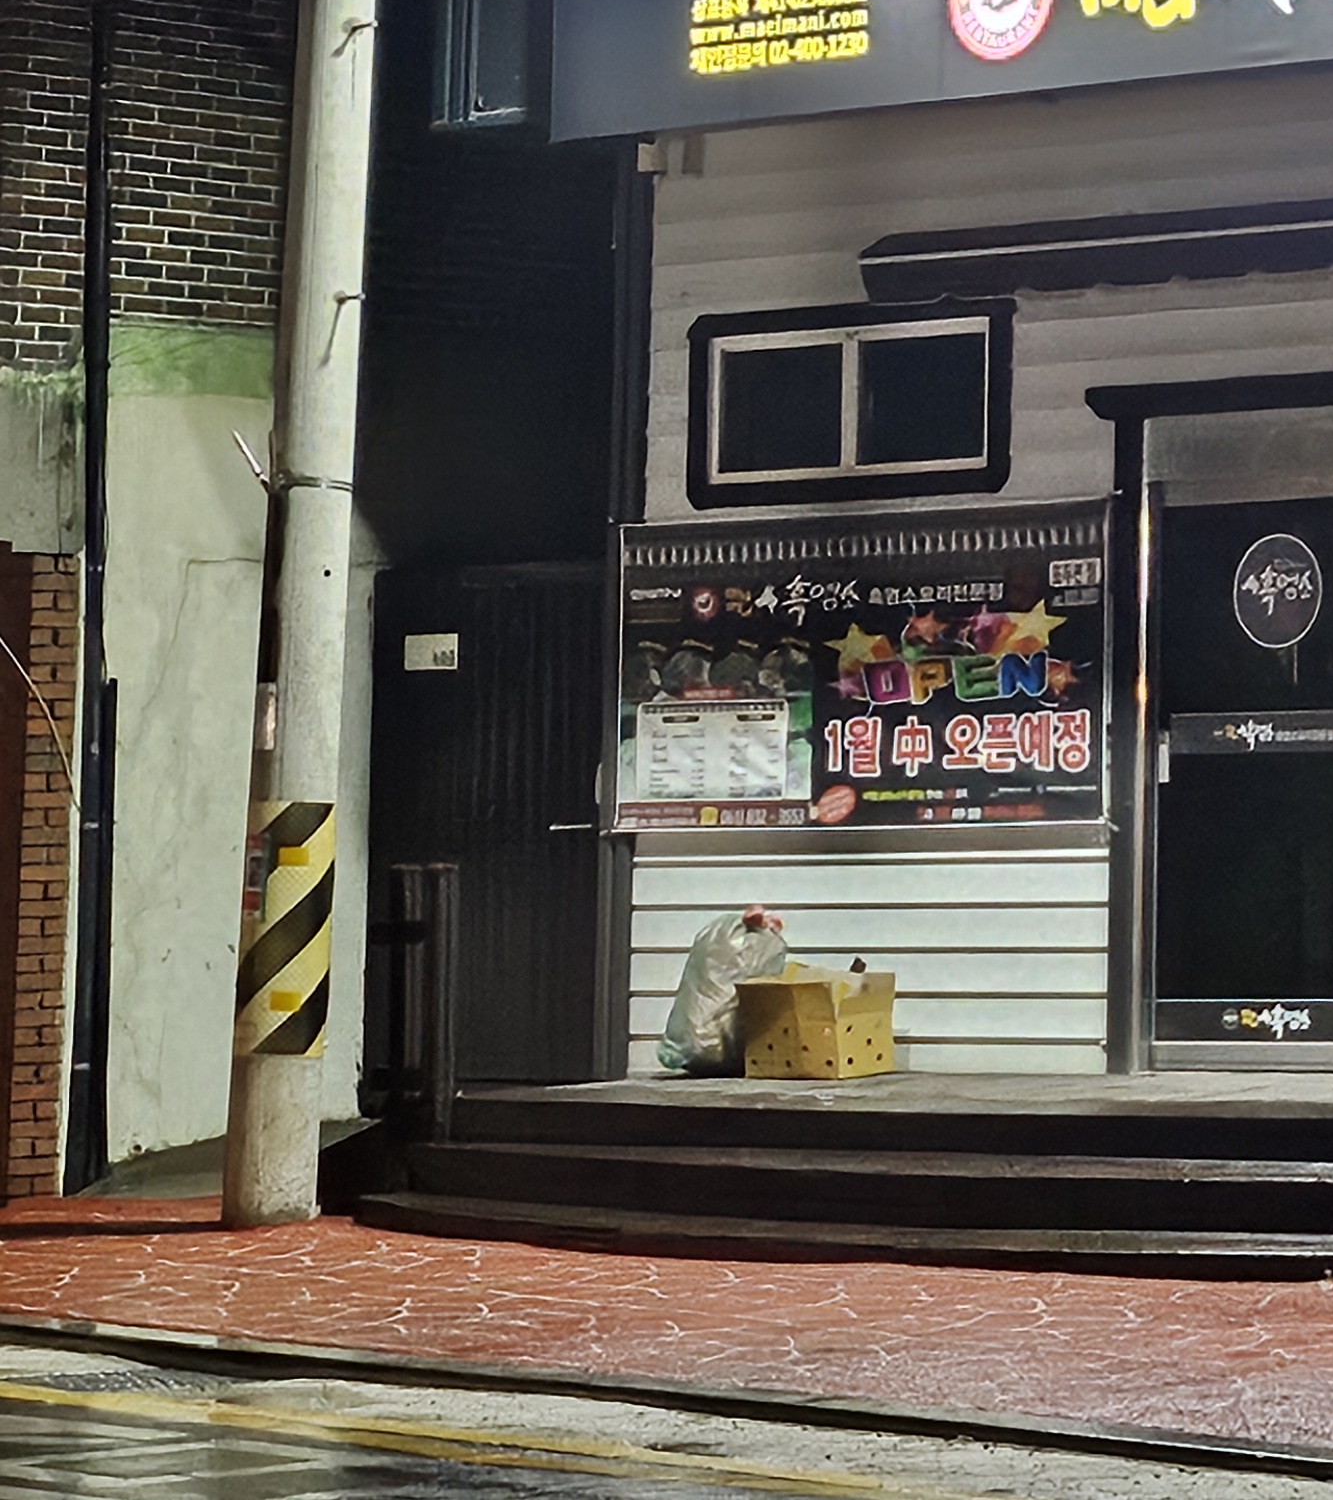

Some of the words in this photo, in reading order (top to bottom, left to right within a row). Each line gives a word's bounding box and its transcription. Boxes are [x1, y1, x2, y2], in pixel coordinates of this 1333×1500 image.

[862, 650, 1049, 705] OPEN
[824, 716, 882, 778] 1월
[892, 715, 934, 778] 中
[942, 708, 1092, 774] 오픈예정
